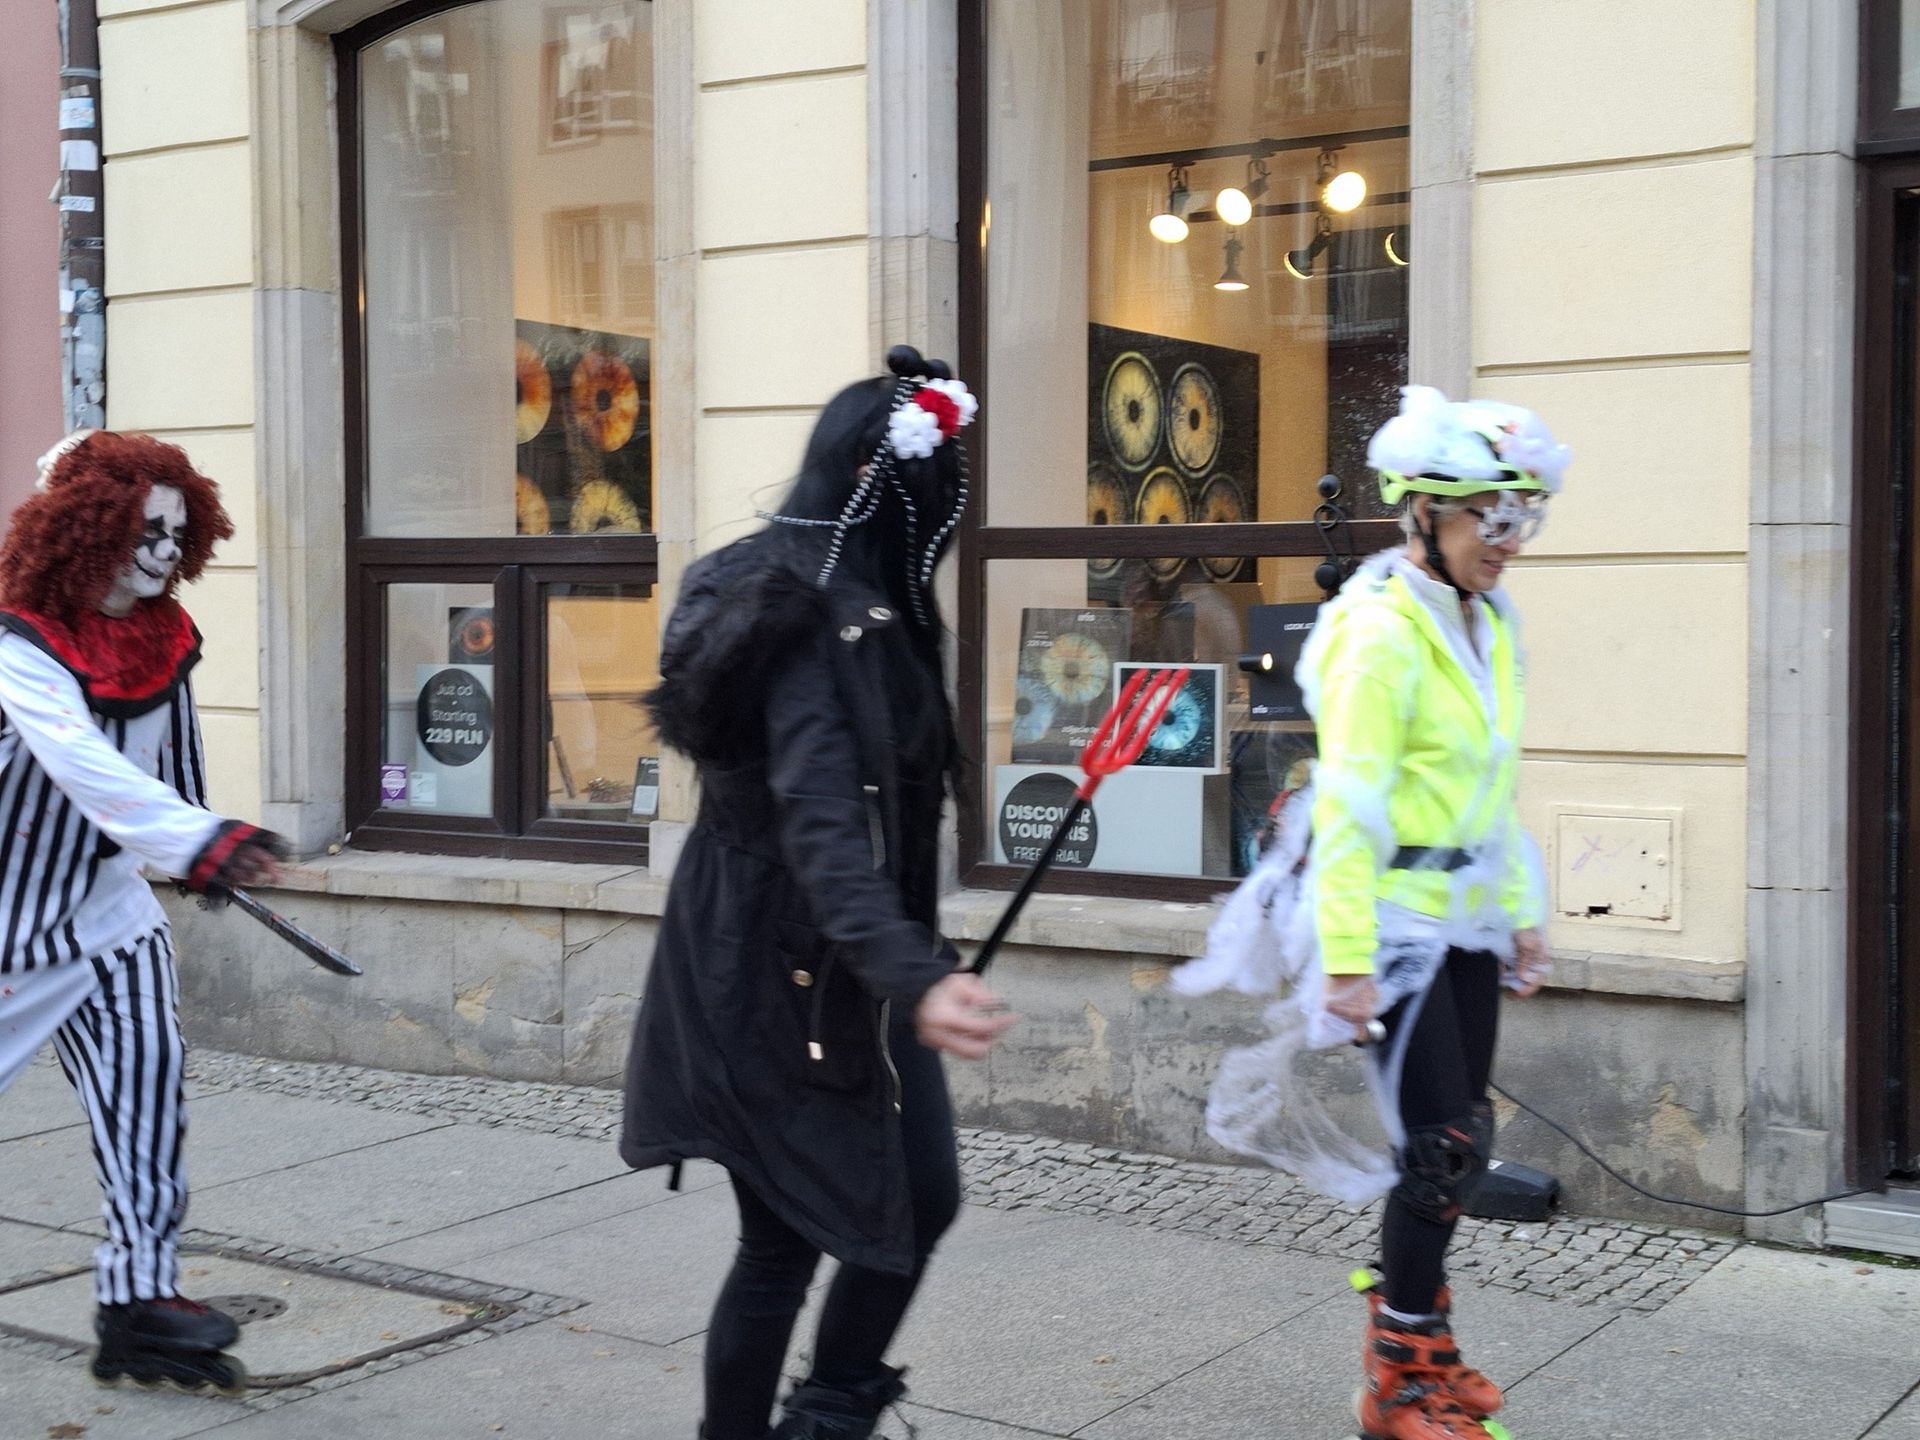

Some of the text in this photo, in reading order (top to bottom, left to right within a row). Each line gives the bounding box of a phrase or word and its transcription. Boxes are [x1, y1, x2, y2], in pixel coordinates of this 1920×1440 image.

[432, 709, 477, 726] Starting
[425, 727, 484, 745] 229 PLN
[1005, 804, 1091, 824] DISCOVR
[1007, 822, 1053, 839] YOUR
[1055, 848, 1082, 864] RIAL
